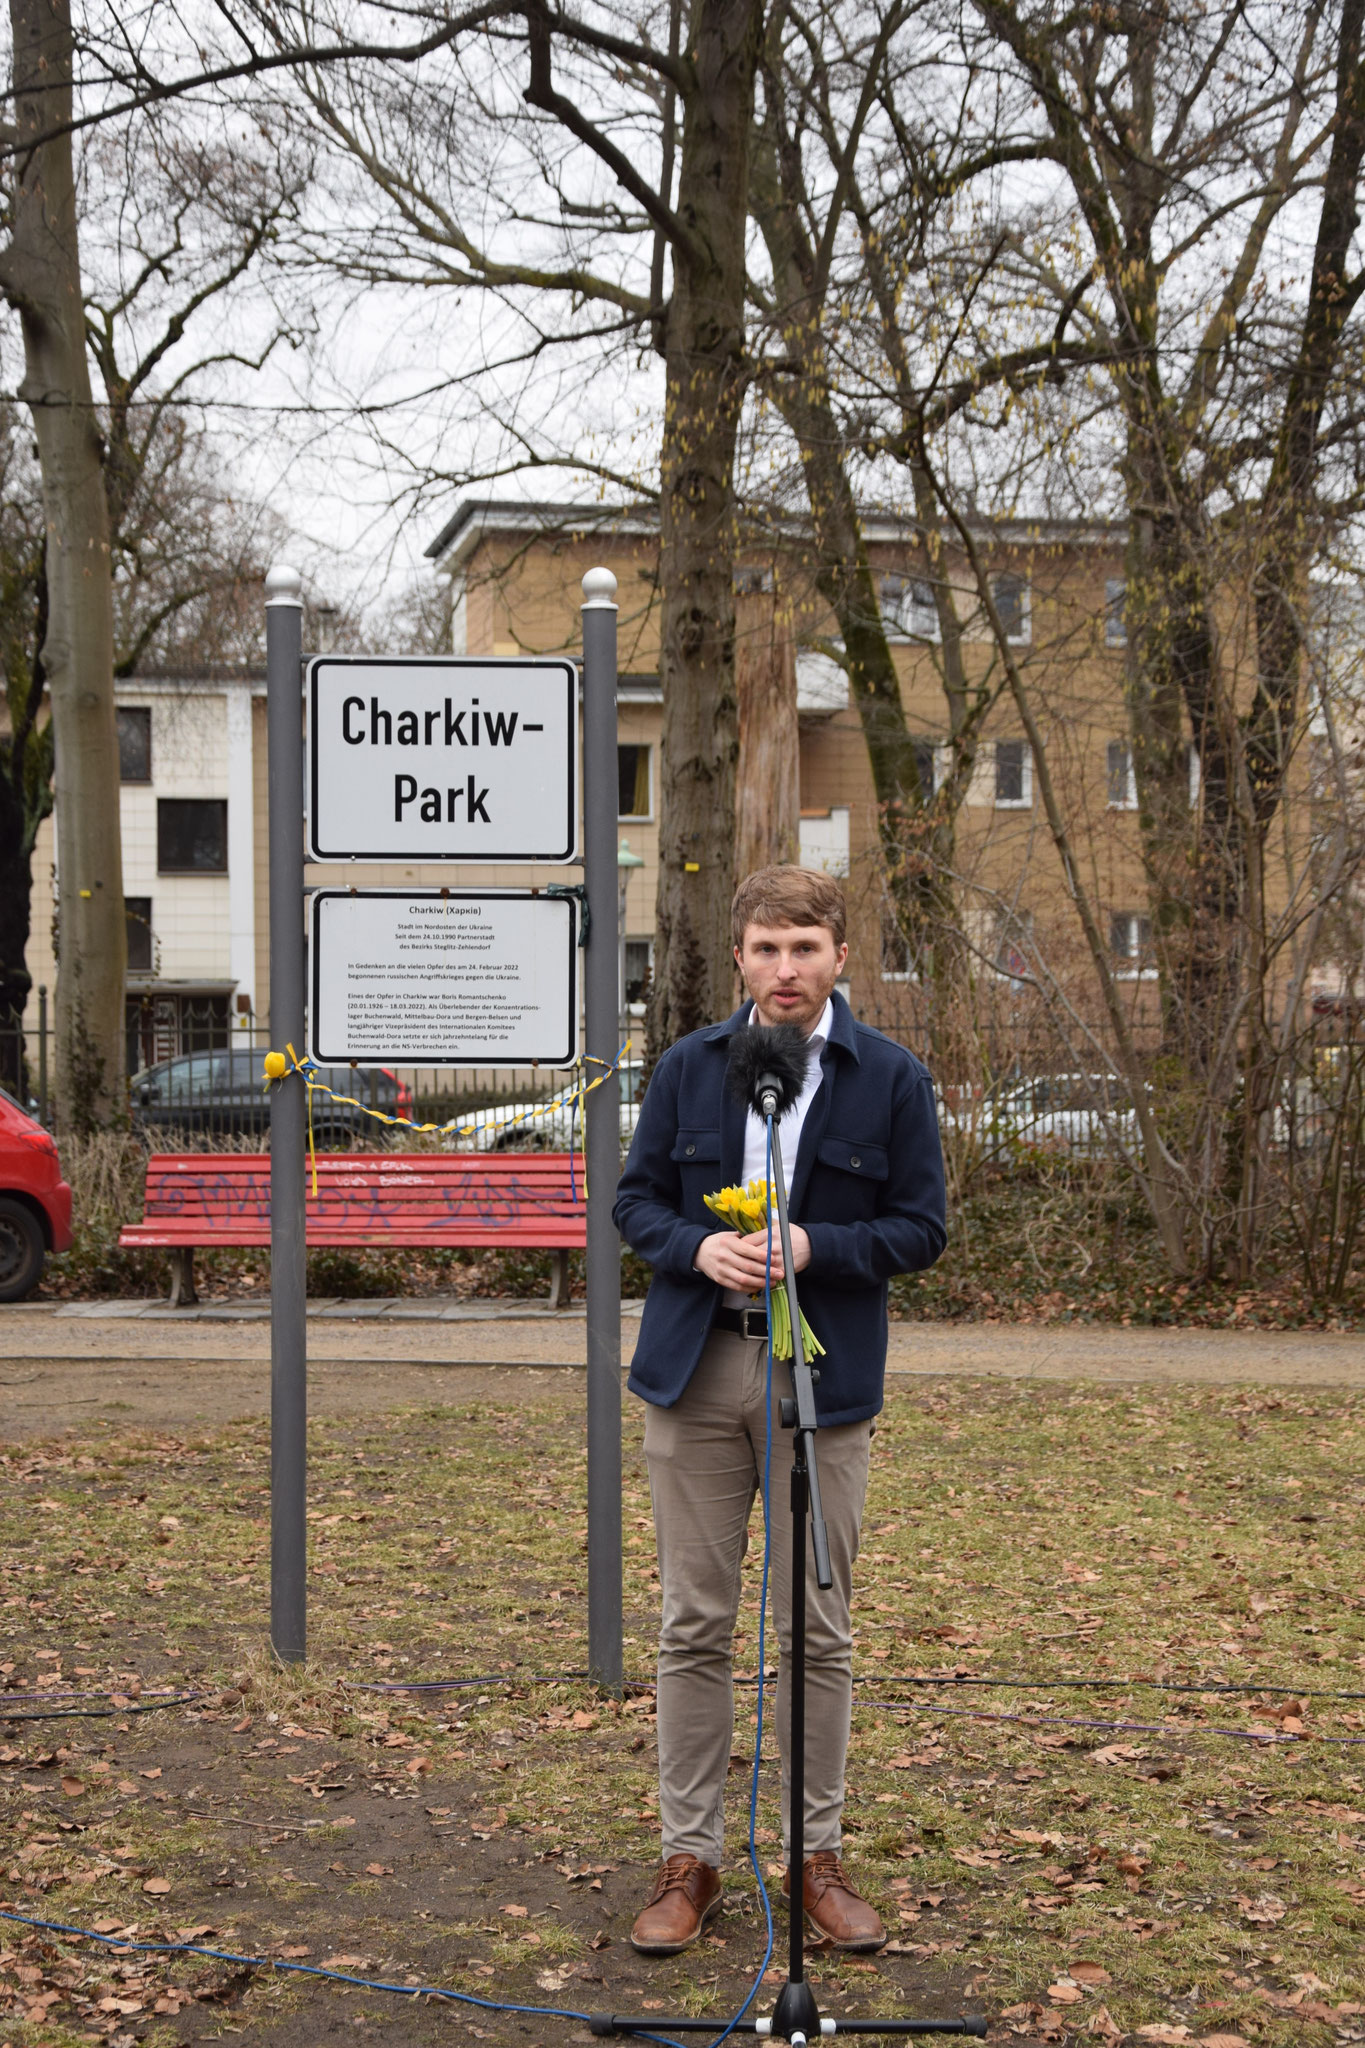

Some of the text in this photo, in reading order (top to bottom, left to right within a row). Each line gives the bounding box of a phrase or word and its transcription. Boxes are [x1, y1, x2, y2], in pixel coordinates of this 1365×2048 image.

[343, 697, 543, 746] Charkiw-
[395, 774, 491, 823] Park
[409, 906, 481, 916] Charkiw (Харків)
[420, 973, 464, 982] Angriffskrieges
